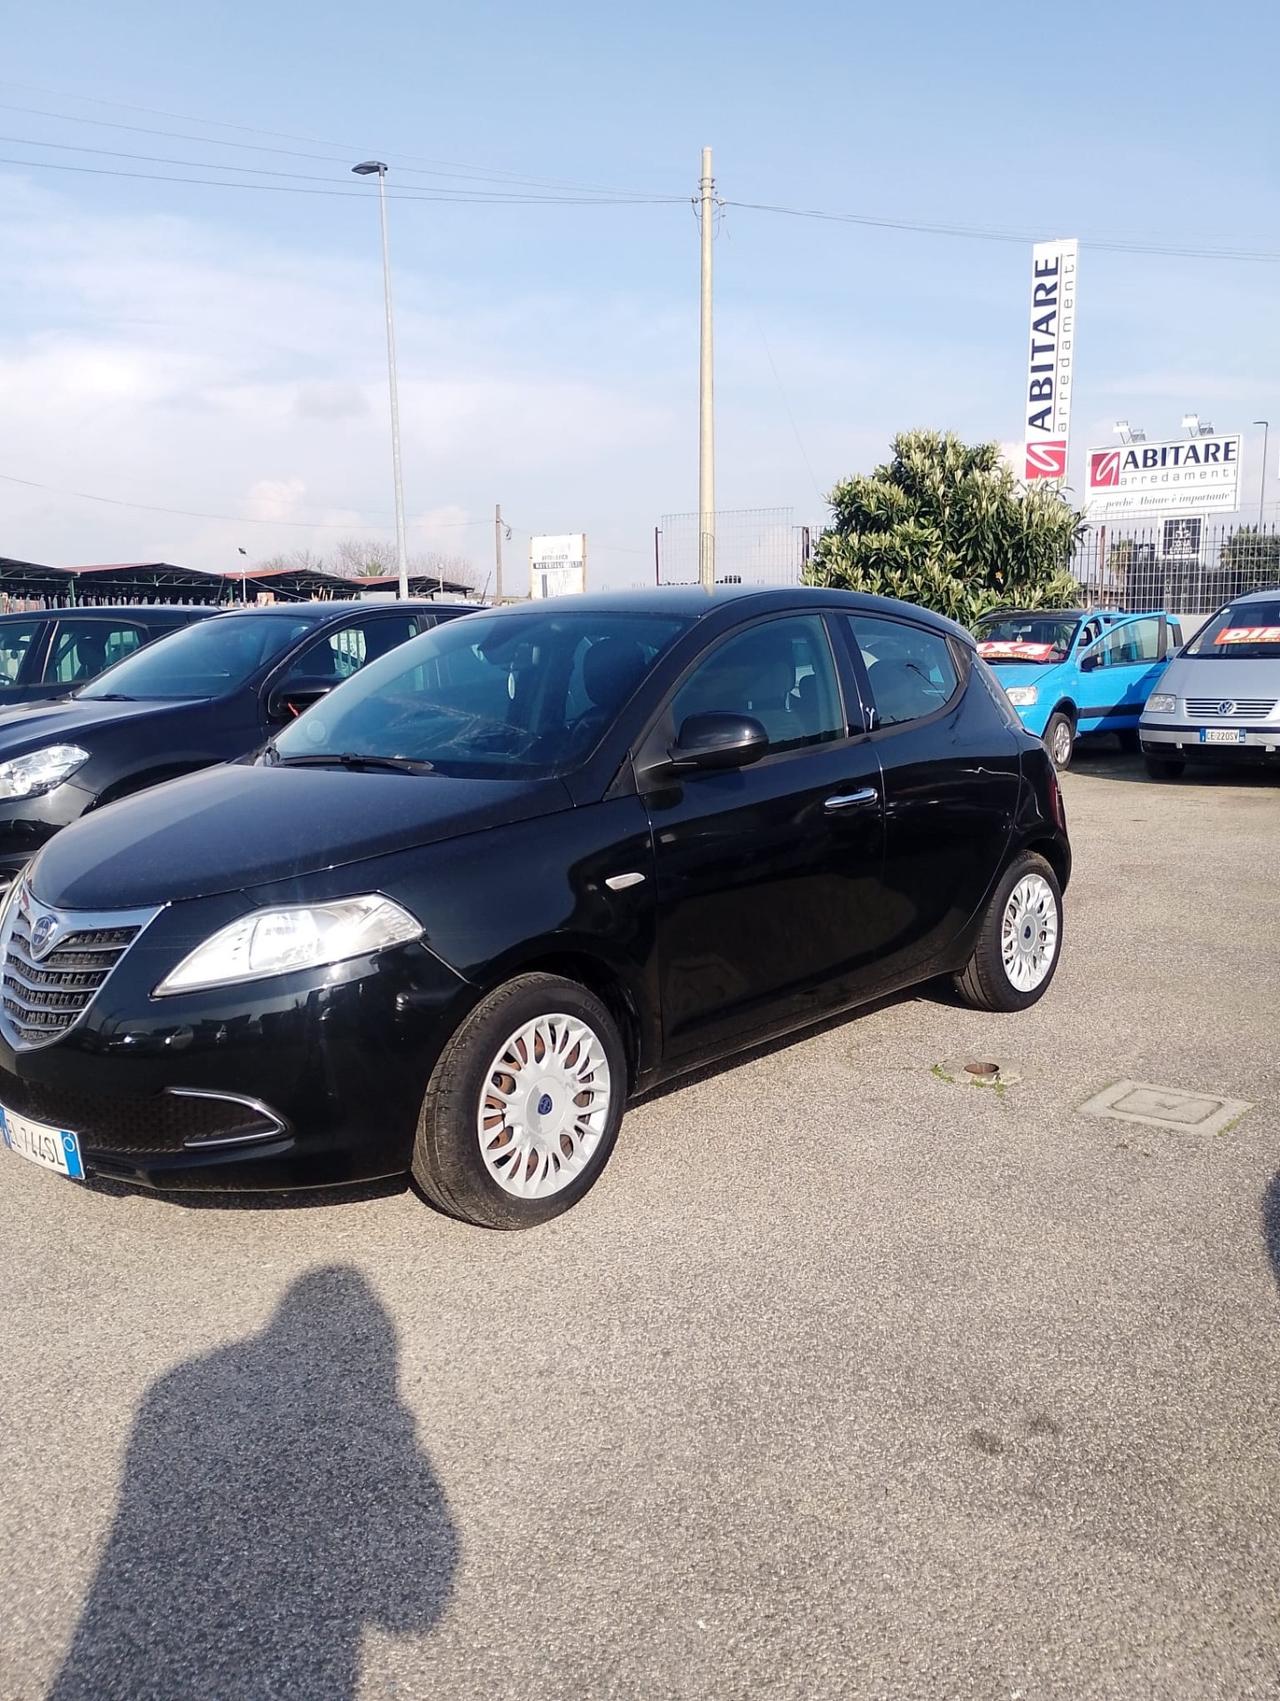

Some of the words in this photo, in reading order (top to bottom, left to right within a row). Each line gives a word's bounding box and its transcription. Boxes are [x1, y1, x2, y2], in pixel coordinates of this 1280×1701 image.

[1028, 256, 1059, 432] ABITARE
[1058, 253, 1075, 432] arredamenti
[1120, 467, 1236, 486] arredamenti
[1122, 441, 1237, 470] ABITARE
